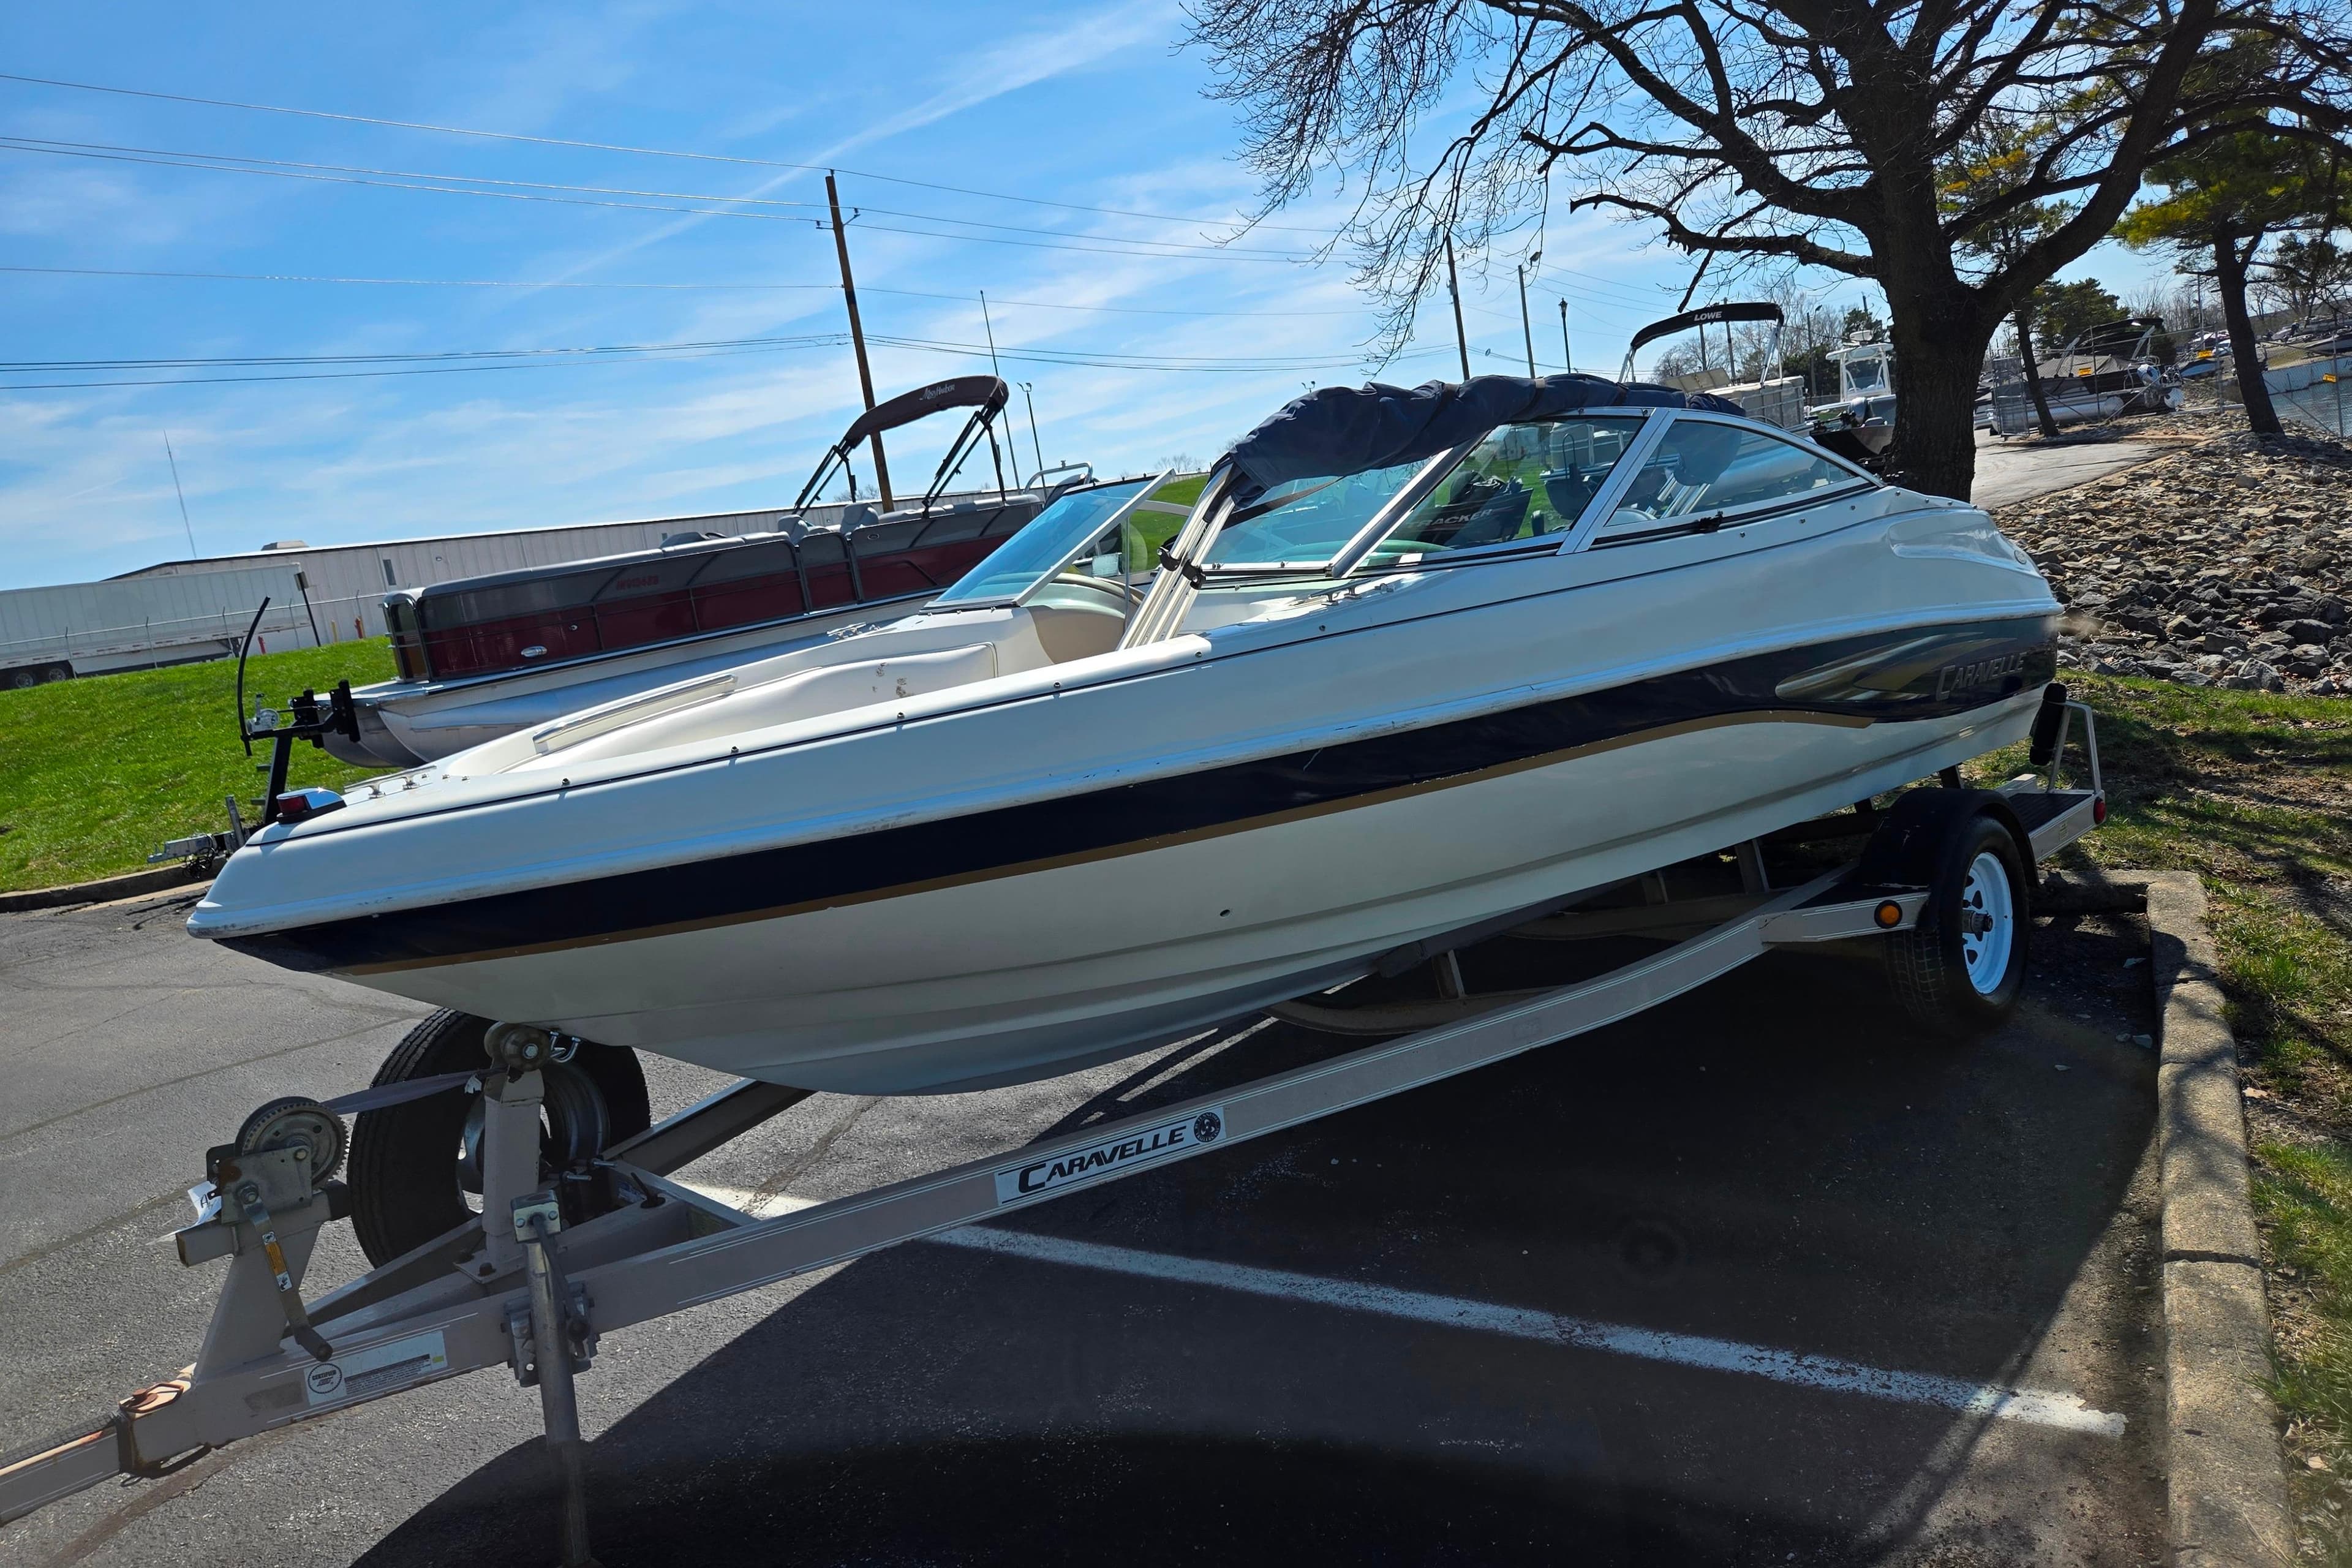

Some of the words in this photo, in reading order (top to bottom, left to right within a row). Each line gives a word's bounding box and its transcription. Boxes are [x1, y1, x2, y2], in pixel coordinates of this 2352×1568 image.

[1694, 311, 1722, 322] LOWE
[1407, 509, 1493, 528] TRACKER
[1936, 652, 2027, 701] CARAVELLE
[1018, 1125, 1187, 1194] CARAVELLE
